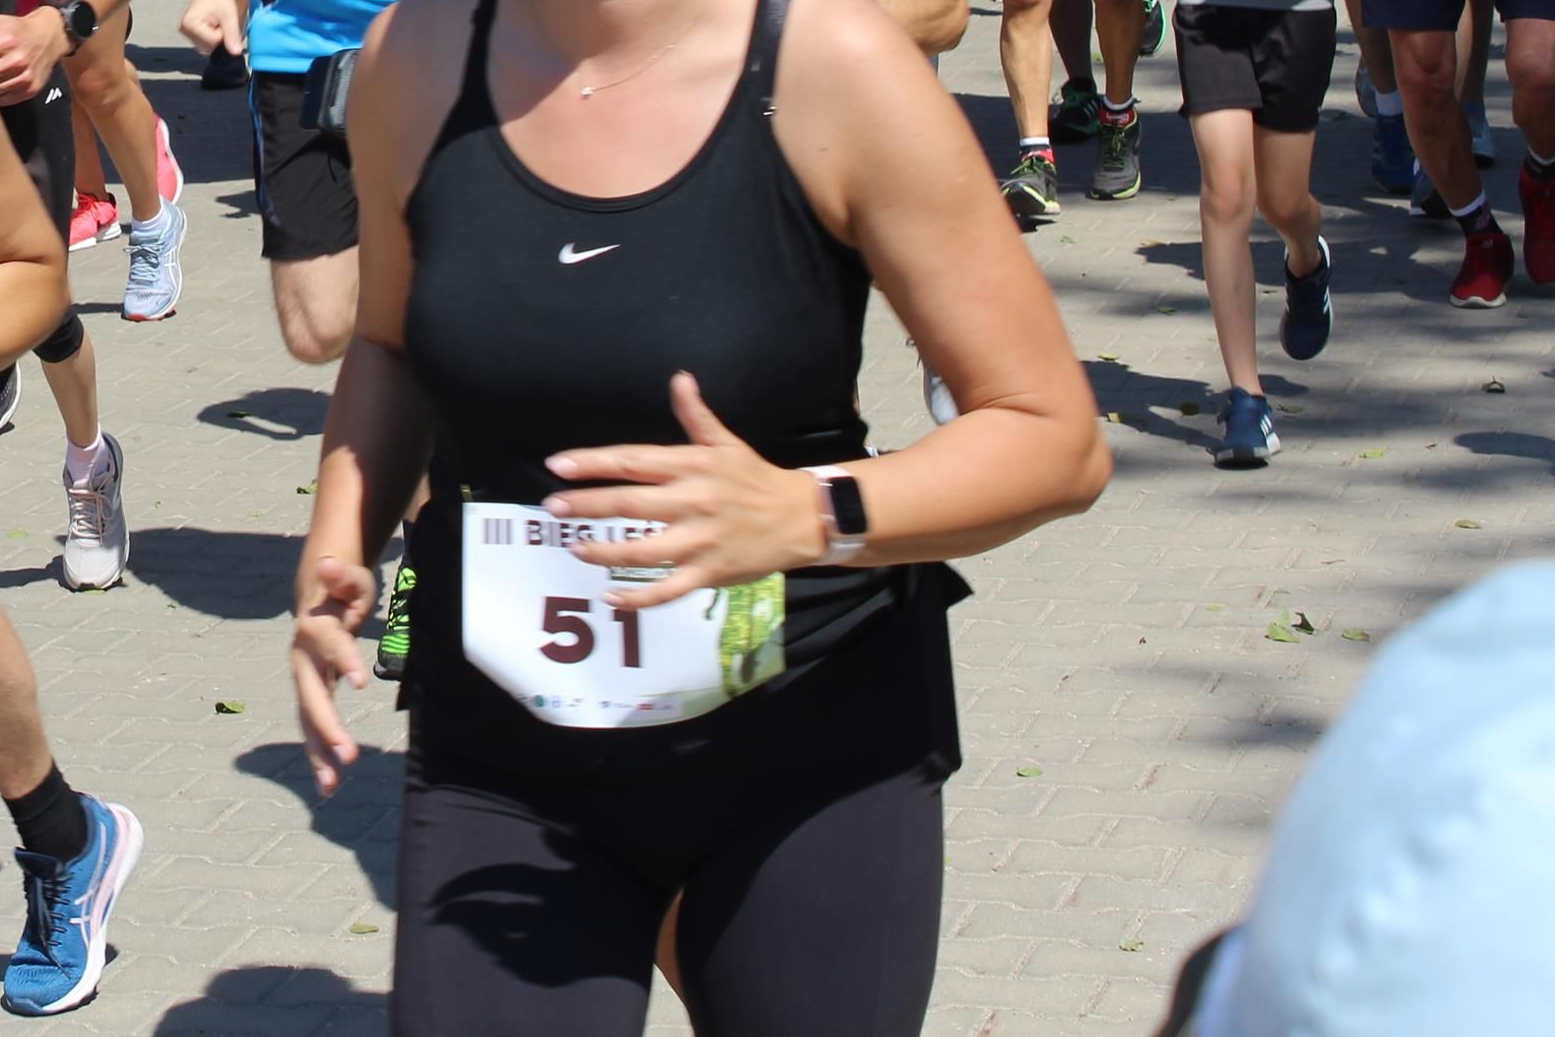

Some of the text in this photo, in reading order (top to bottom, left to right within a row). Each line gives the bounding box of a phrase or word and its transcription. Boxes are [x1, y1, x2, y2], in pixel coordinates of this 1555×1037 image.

[483, 518, 513, 545] III
[525, 519, 595, 548] BIEG
[539, 595, 642, 669] 51
